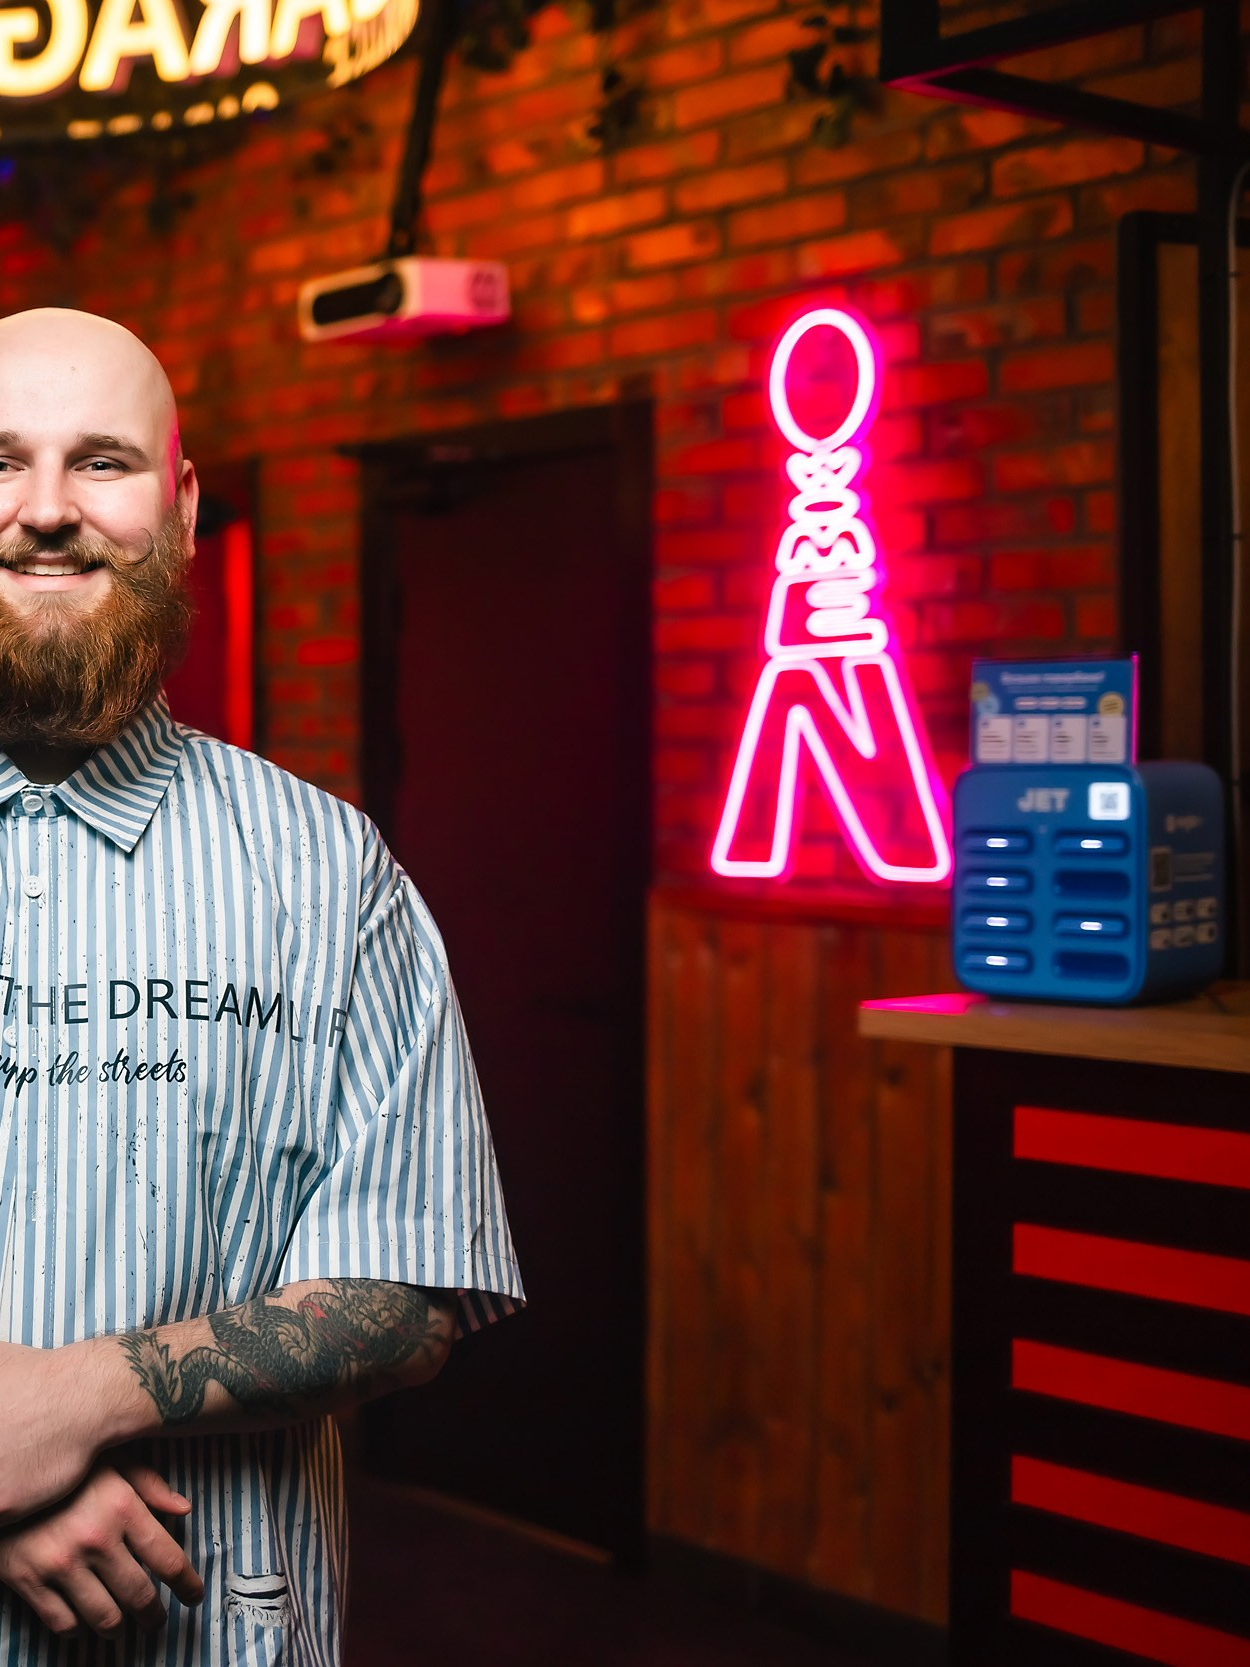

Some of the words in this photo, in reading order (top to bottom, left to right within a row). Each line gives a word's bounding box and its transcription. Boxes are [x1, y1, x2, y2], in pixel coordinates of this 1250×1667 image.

[1017, 787, 1070, 813] JET
[0, 974, 89, 1025] THE
[46, 1050, 93, 1087] the
[98, 1047, 187, 1085] streets
